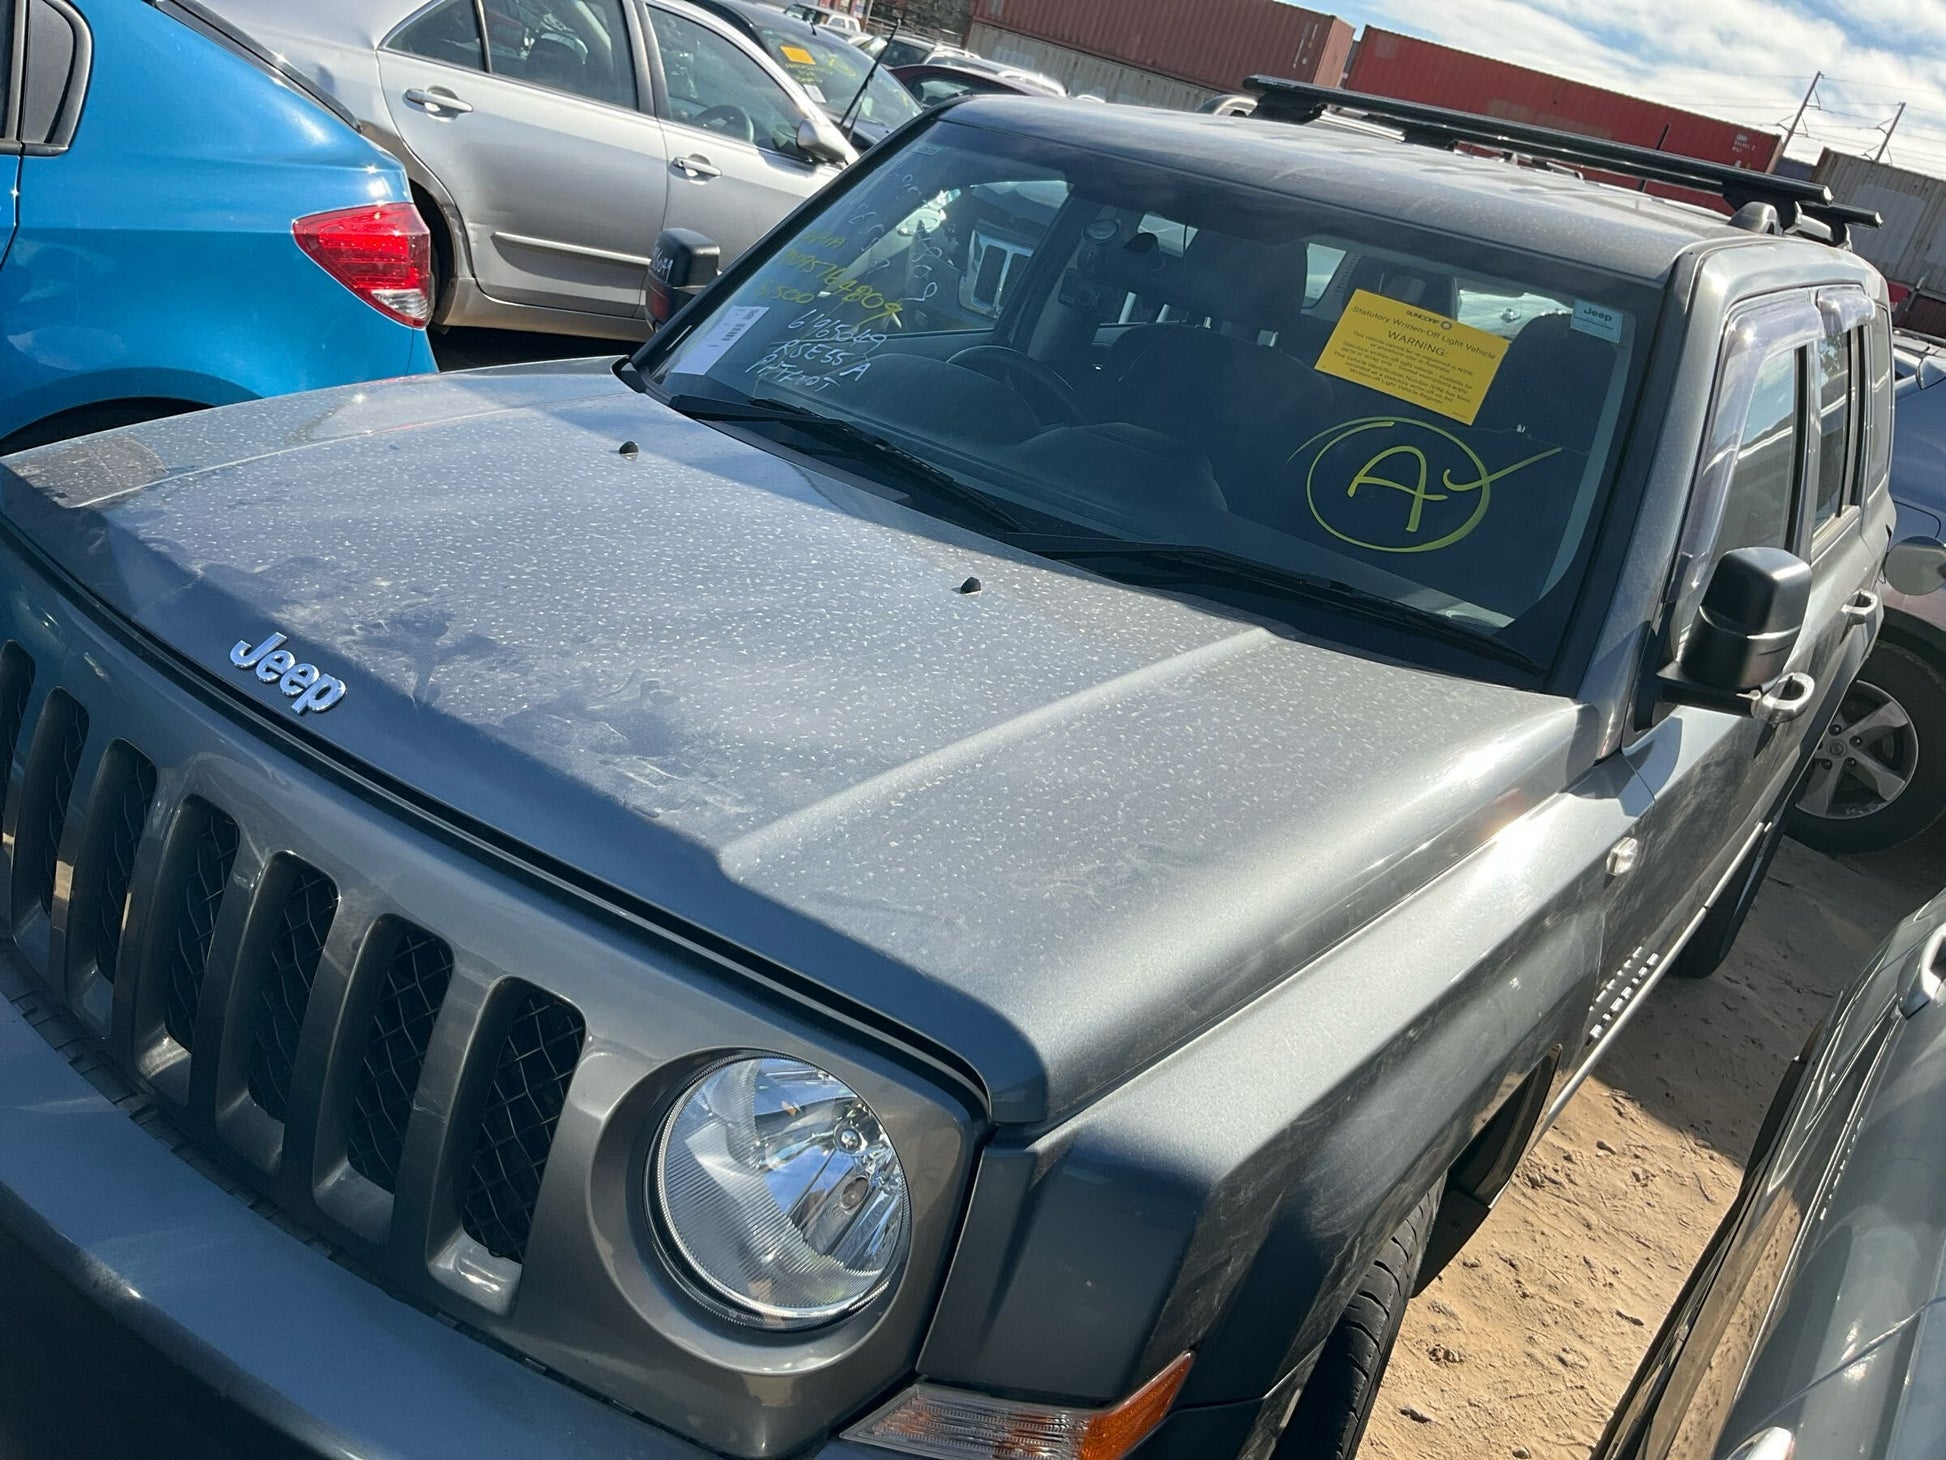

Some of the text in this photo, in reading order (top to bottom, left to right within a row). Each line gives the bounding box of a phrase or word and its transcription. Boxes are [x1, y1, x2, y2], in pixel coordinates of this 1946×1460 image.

[1405, 309, 1440, 325] SUNCORP
[1583, 307, 1613, 322] Jeep
[1352, 305, 1497, 359] Statutory Written-Off Light Vehicle
[1386, 330, 1448, 357] WARNING:
[839, 362, 872, 382] A
[1347, 445, 1448, 532] A
[229, 631, 347, 714] Jeep
